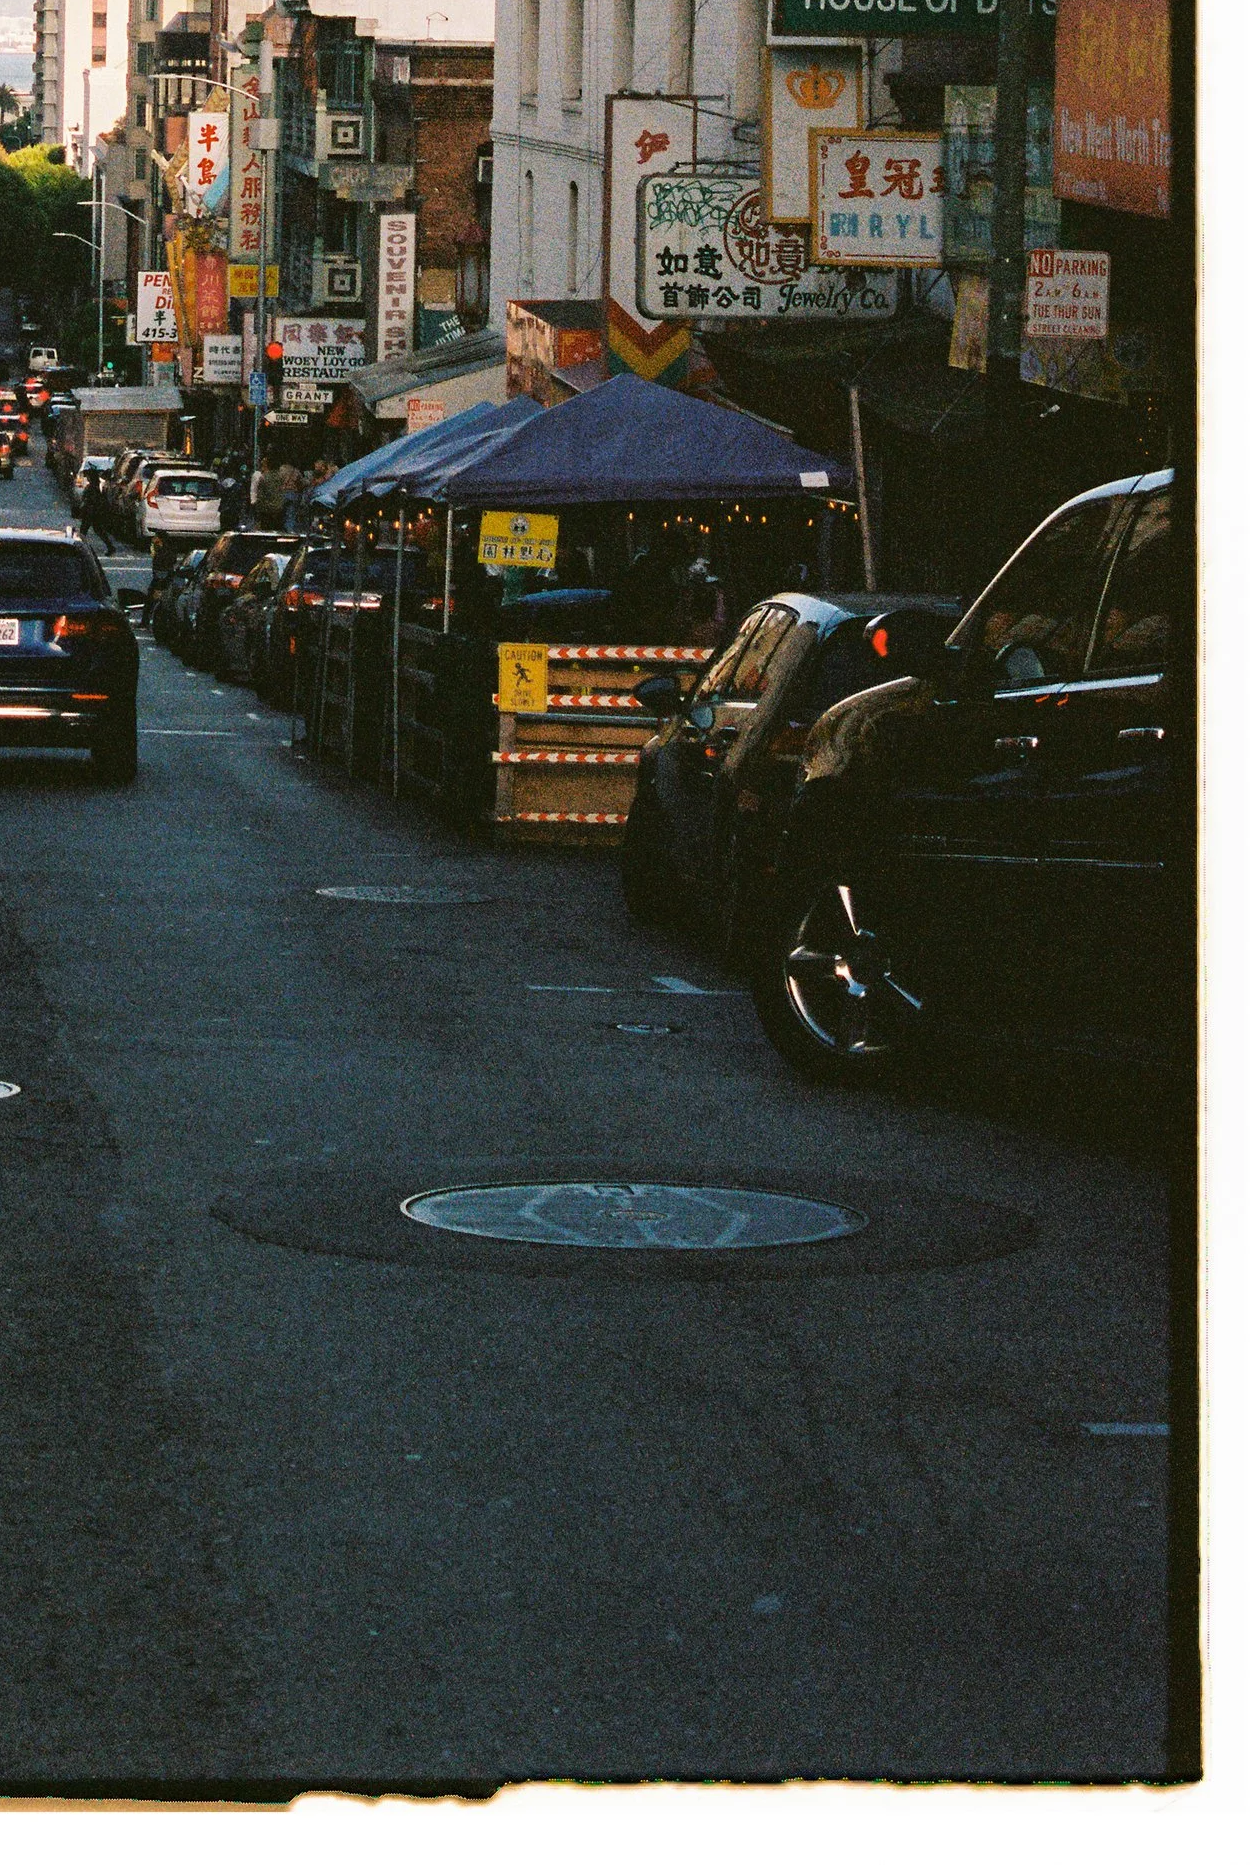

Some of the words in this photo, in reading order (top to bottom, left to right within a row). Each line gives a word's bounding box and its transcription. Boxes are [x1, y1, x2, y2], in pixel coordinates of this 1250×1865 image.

[197, 122, 220, 188] 半島
[655, 242, 724, 281] 如意
[1030, 252, 1052, 277] NO
[1055, 258, 1107, 277] PARKING
[384, 220, 407, 321] SOUVENIR
[143, 274, 172, 287] PEN
[659, 282, 762, 310] 首飾公司
[1034, 281, 1045, 297] 2
[1072, 282, 1081, 298] 6
[155, 295, 174, 309] Di
[777, 283, 852, 316] Jewelry
[1033, 303, 1051, 318] TUE
[1053, 304, 1078, 319] THUR
[1081, 305, 1101, 320] SUN
[438, 314, 460, 332] THE
[1032, 324, 1061, 333] STREET
[316, 345, 347, 356] NEW
[383, 327, 407, 361] SHO
[282, 355, 319, 367] WOEY
[323, 356, 347, 367] LOY
[349, 357, 366, 367] GO
[286, 391, 330, 401] GRANT
[275, 414, 290, 423] ONE
[291, 414, 307, 423] WAY
[504, 649, 543, 662] CAUTION
